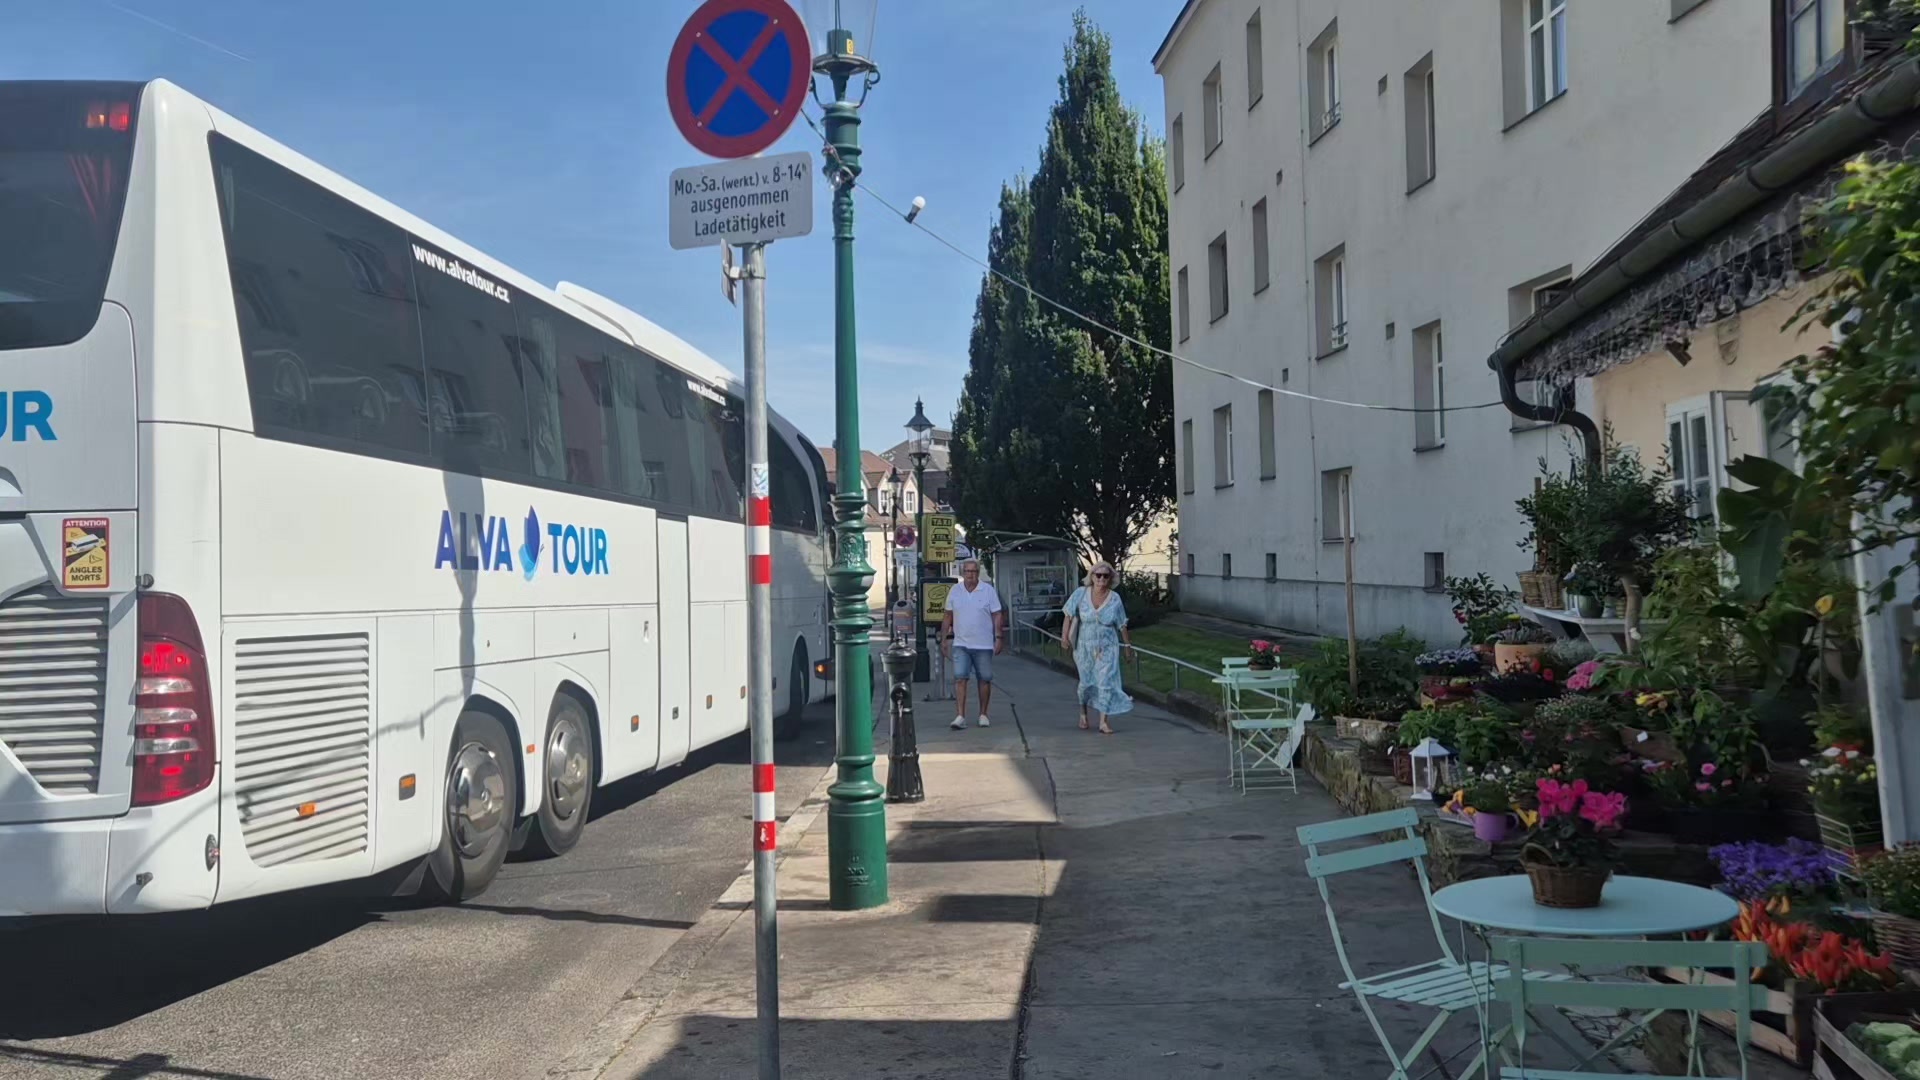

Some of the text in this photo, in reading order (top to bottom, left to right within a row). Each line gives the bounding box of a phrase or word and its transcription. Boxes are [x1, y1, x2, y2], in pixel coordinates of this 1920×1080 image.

[691, 189, 789, 214] ausgenommen
[695, 210, 786, 236] Ladetätigkeit
[412, 243, 511, 303] www.alvatour.cz
[0, 390, 58, 441] R
[932, 518, 951, 526] TAXI
[434, 510, 609, 575] ALVA TOUR
[69, 566, 102, 574] ANGLES
[71, 574, 101, 582] MORTS
